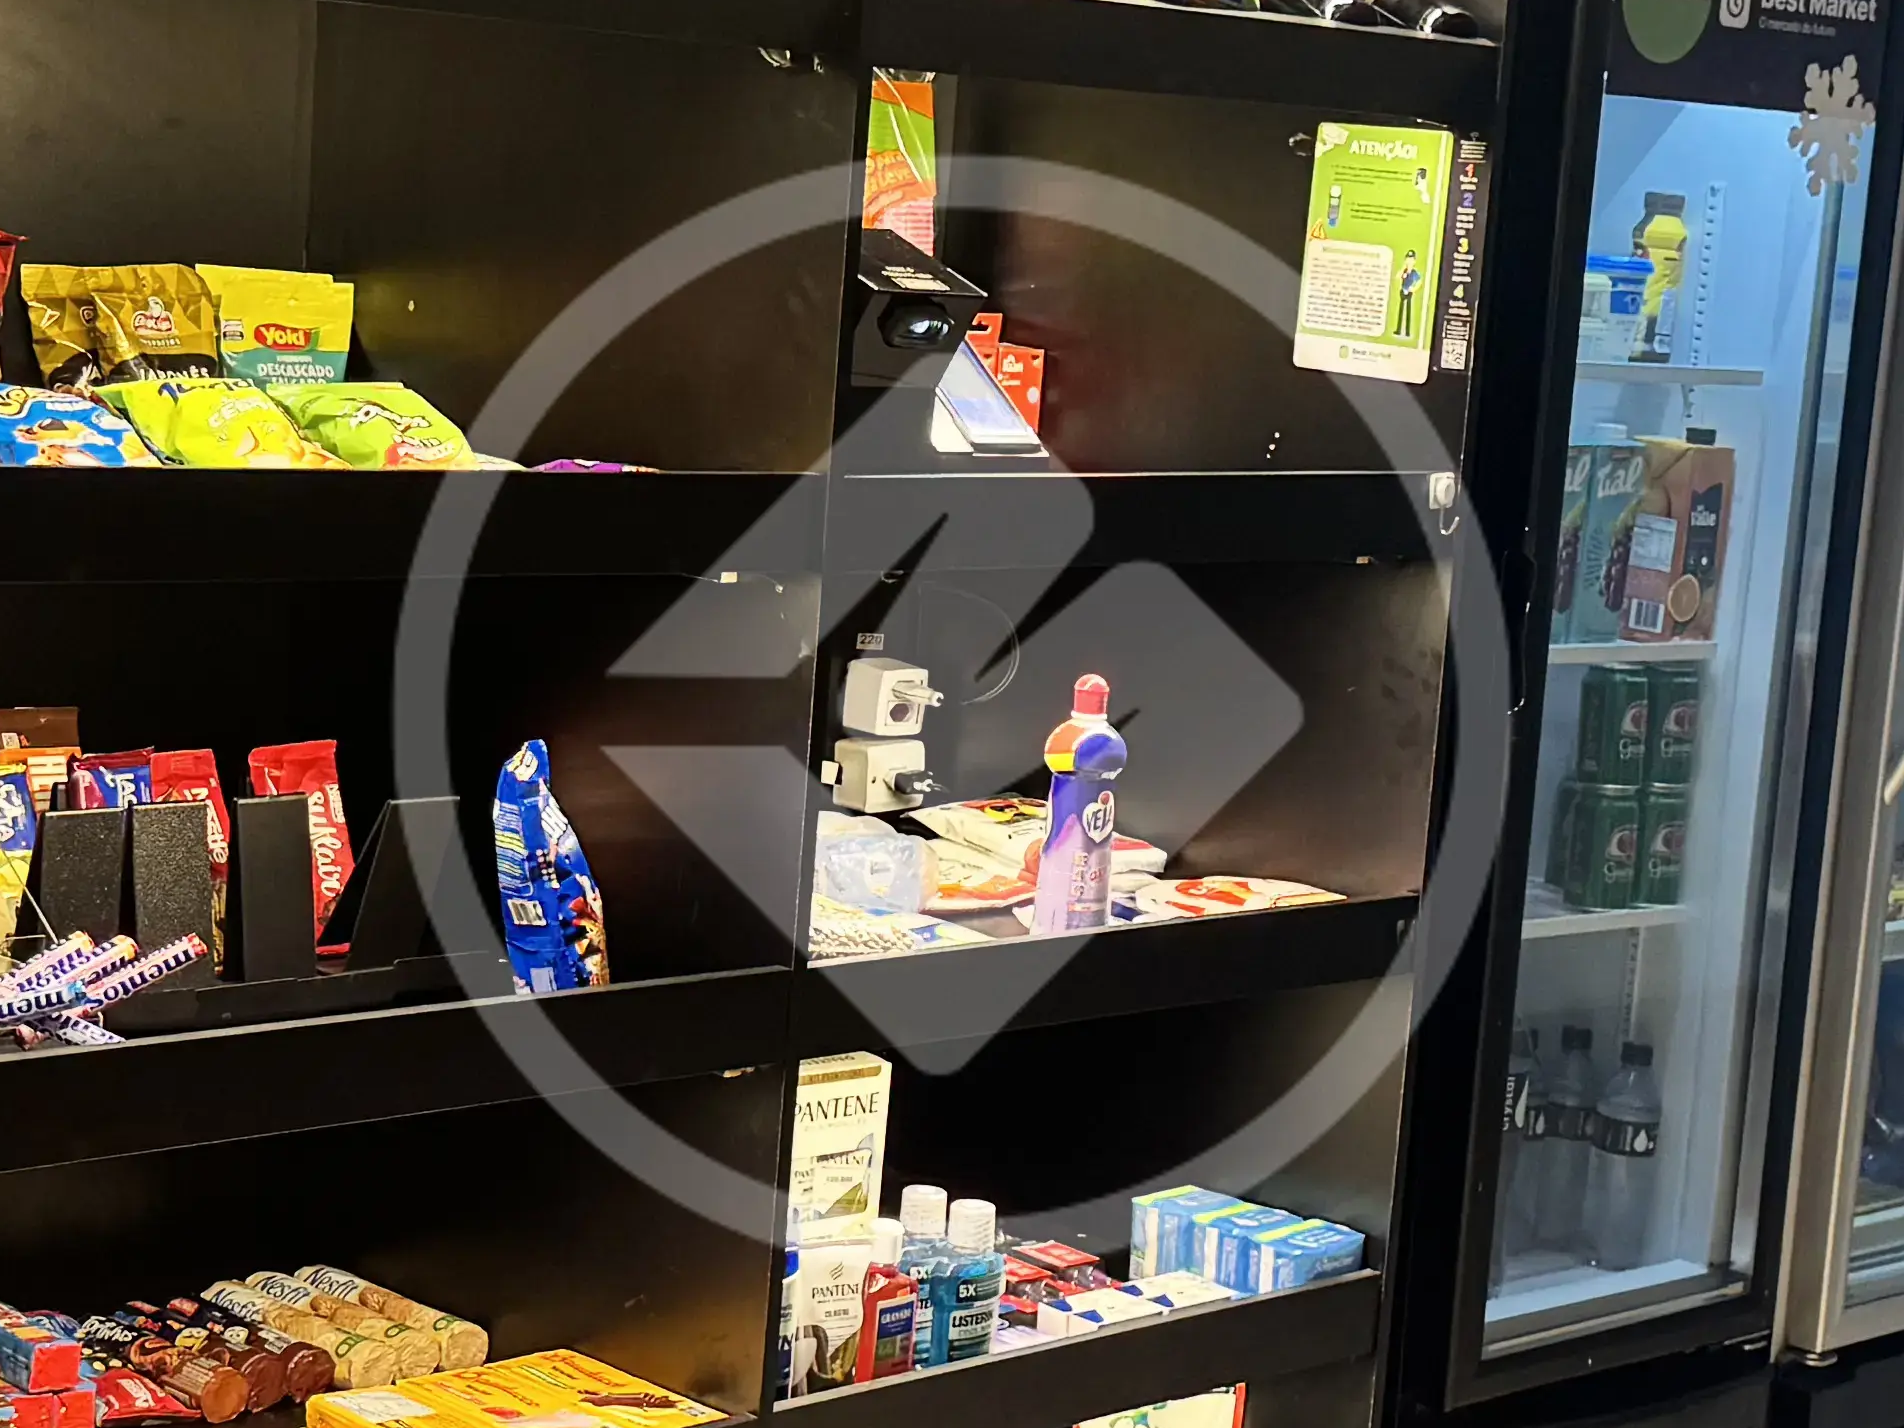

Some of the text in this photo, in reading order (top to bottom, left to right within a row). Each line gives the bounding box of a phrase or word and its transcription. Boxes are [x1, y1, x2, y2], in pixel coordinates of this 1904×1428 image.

[1349, 139, 1418, 161] ATENÇÃO!
[1463, 193, 1474, 207] 2
[1458, 238, 1469, 253] 3
[1453, 284, 1464, 298] 4
[260, 328, 308, 347] Yoki
[257, 362, 334, 378] DESCASCADO
[858, 633, 883, 647] 220
[85, 949, 193, 1012] mentos
[795, 1091, 880, 1122] PANTENE
[259, 1273, 311, 1305] Nesfit
[307, 1265, 359, 1300] Nesfit
[958, 1285, 977, 1298] 5X
